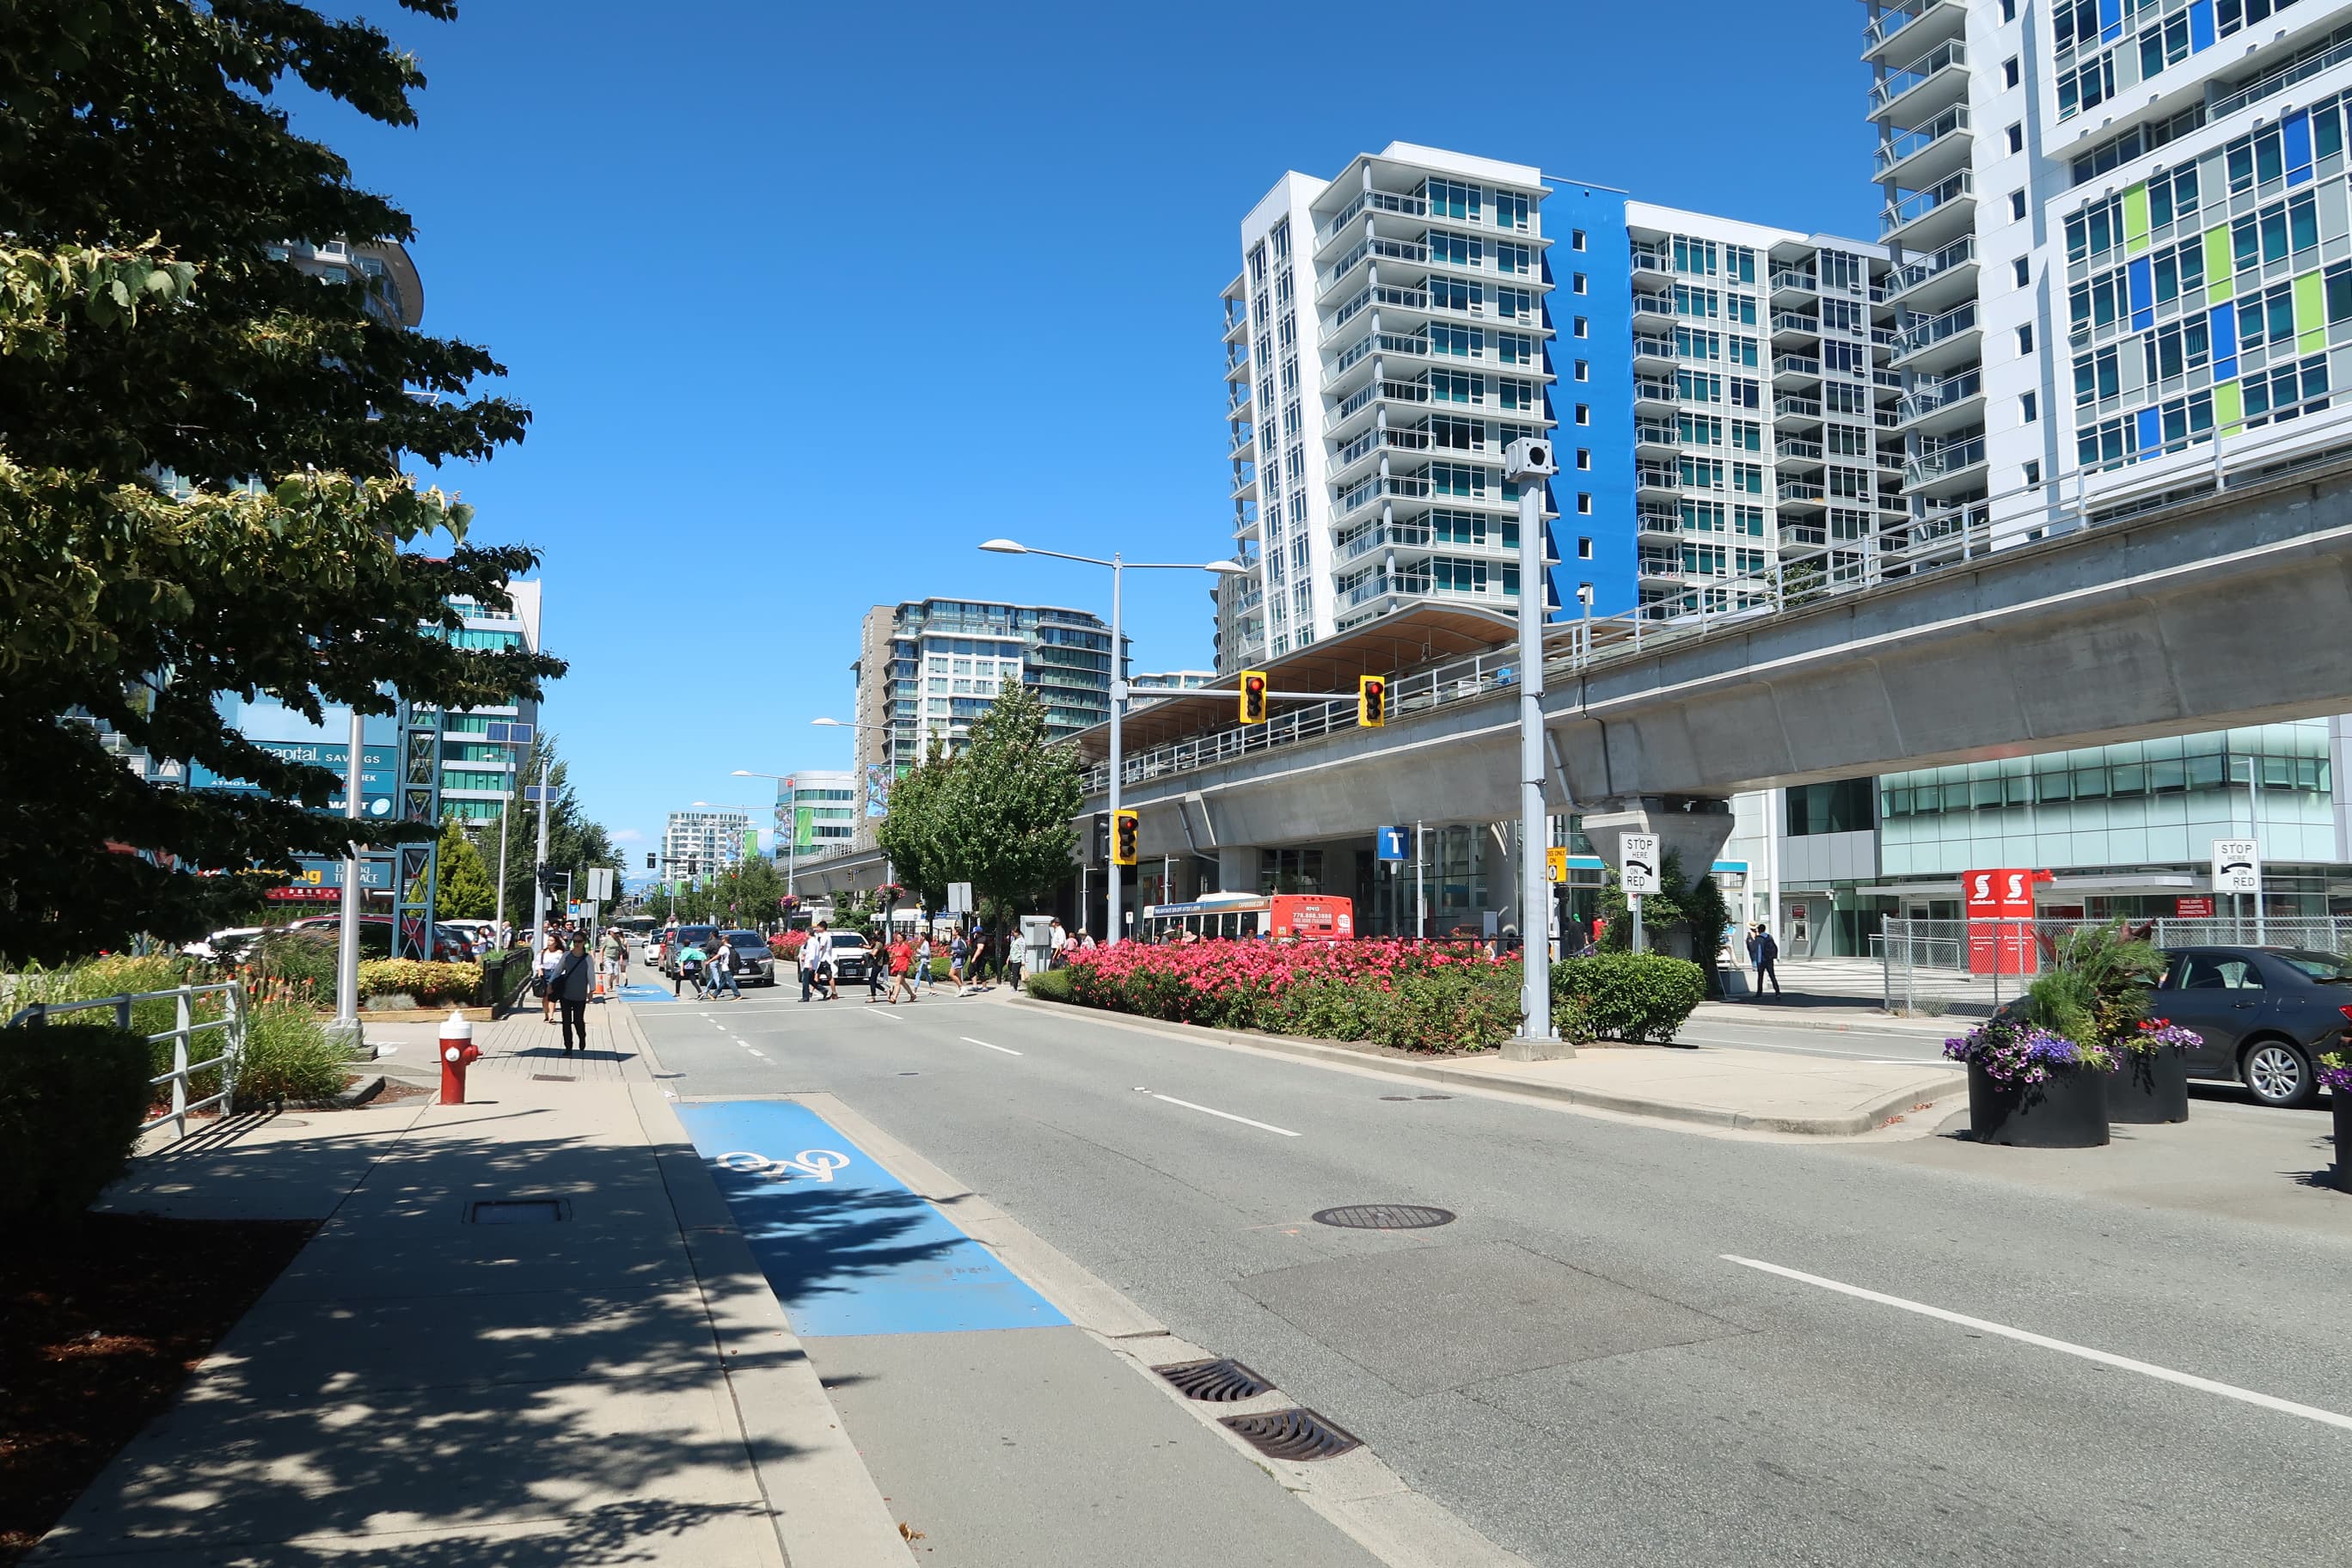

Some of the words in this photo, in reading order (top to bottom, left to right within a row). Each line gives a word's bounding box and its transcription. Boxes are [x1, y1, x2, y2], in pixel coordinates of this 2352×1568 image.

[326, 754, 380, 763] SAVGS
[1387, 832, 1404, 854] T
[1626, 839, 1653, 850] STOP
[2221, 844, 2252, 854] STOP
[1626, 876, 1645, 886] RED
[2233, 877, 2256, 886] RED
